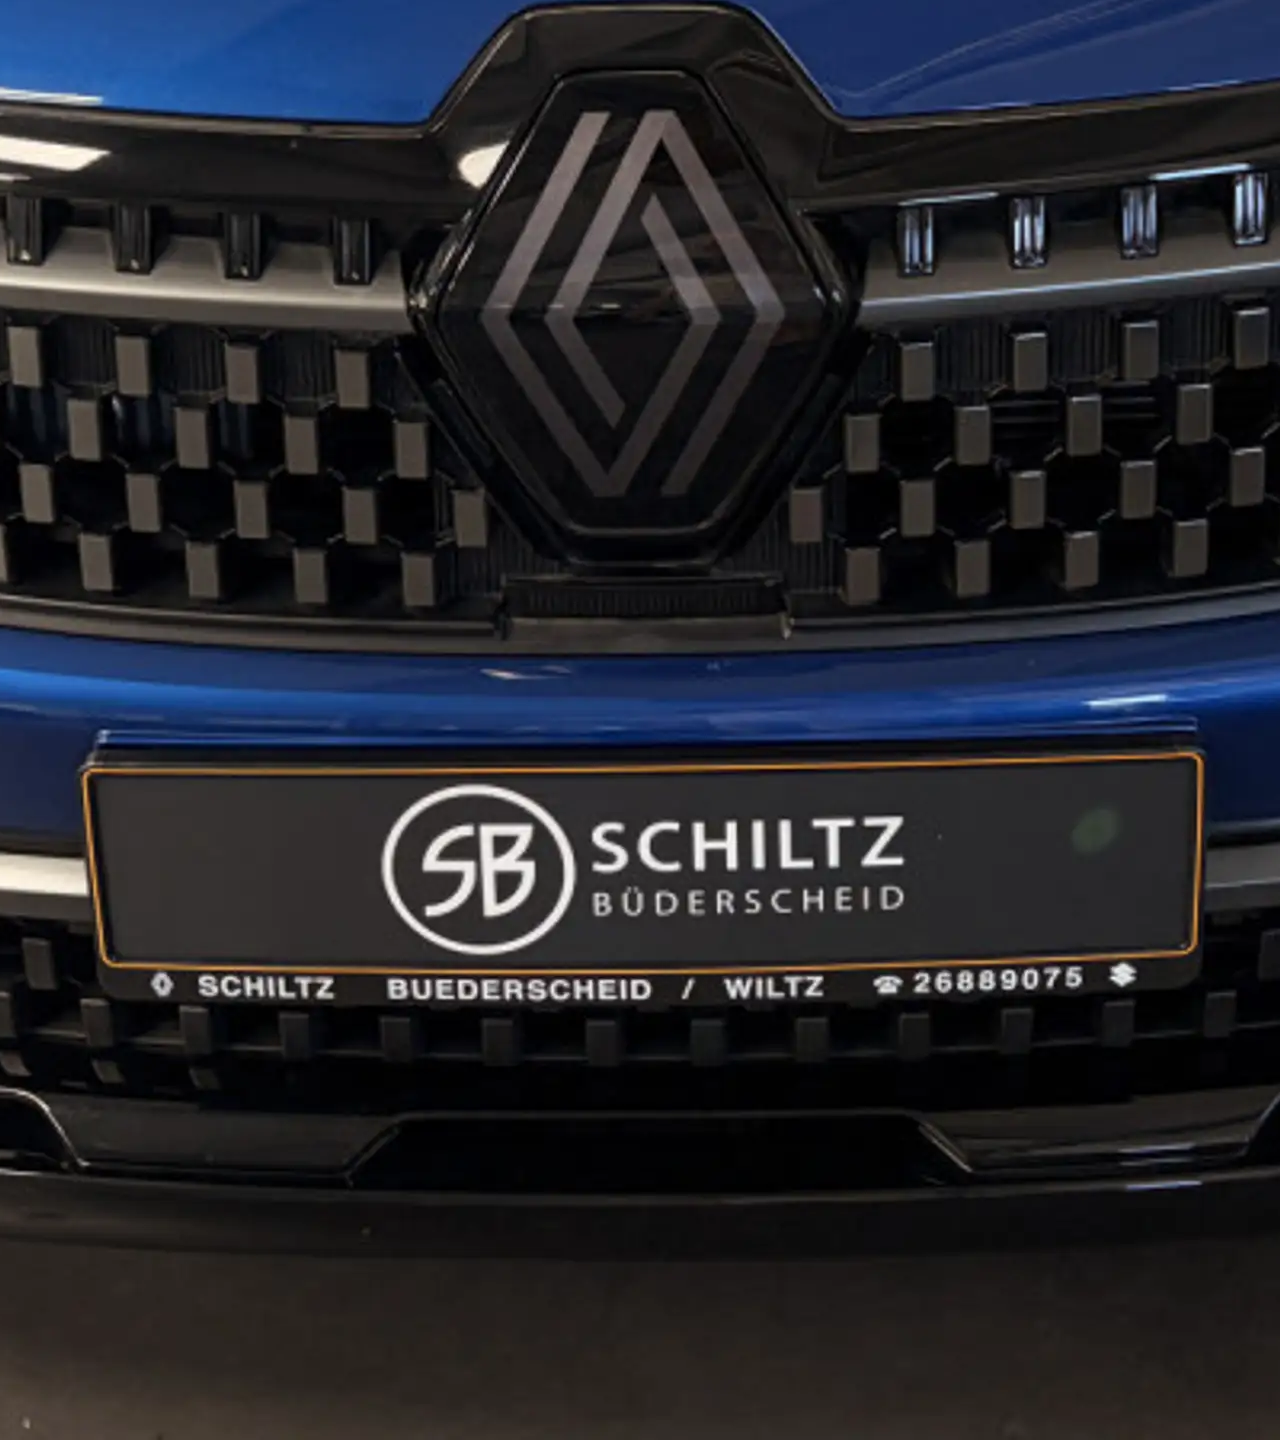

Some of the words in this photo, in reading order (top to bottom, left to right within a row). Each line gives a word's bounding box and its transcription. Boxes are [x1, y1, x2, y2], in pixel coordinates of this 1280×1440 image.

[592, 816, 904, 873] SCHILTZ
[422, 823, 536, 918] SB
[593, 886, 904, 916] BÜDERSCHEID
[199, 975, 334, 999] SCHILTZ
[388, 978, 651, 1001] BUEDERSCHEID
[724, 976, 823, 999] WILTZ
[913, 967, 1083, 994] 26889075
